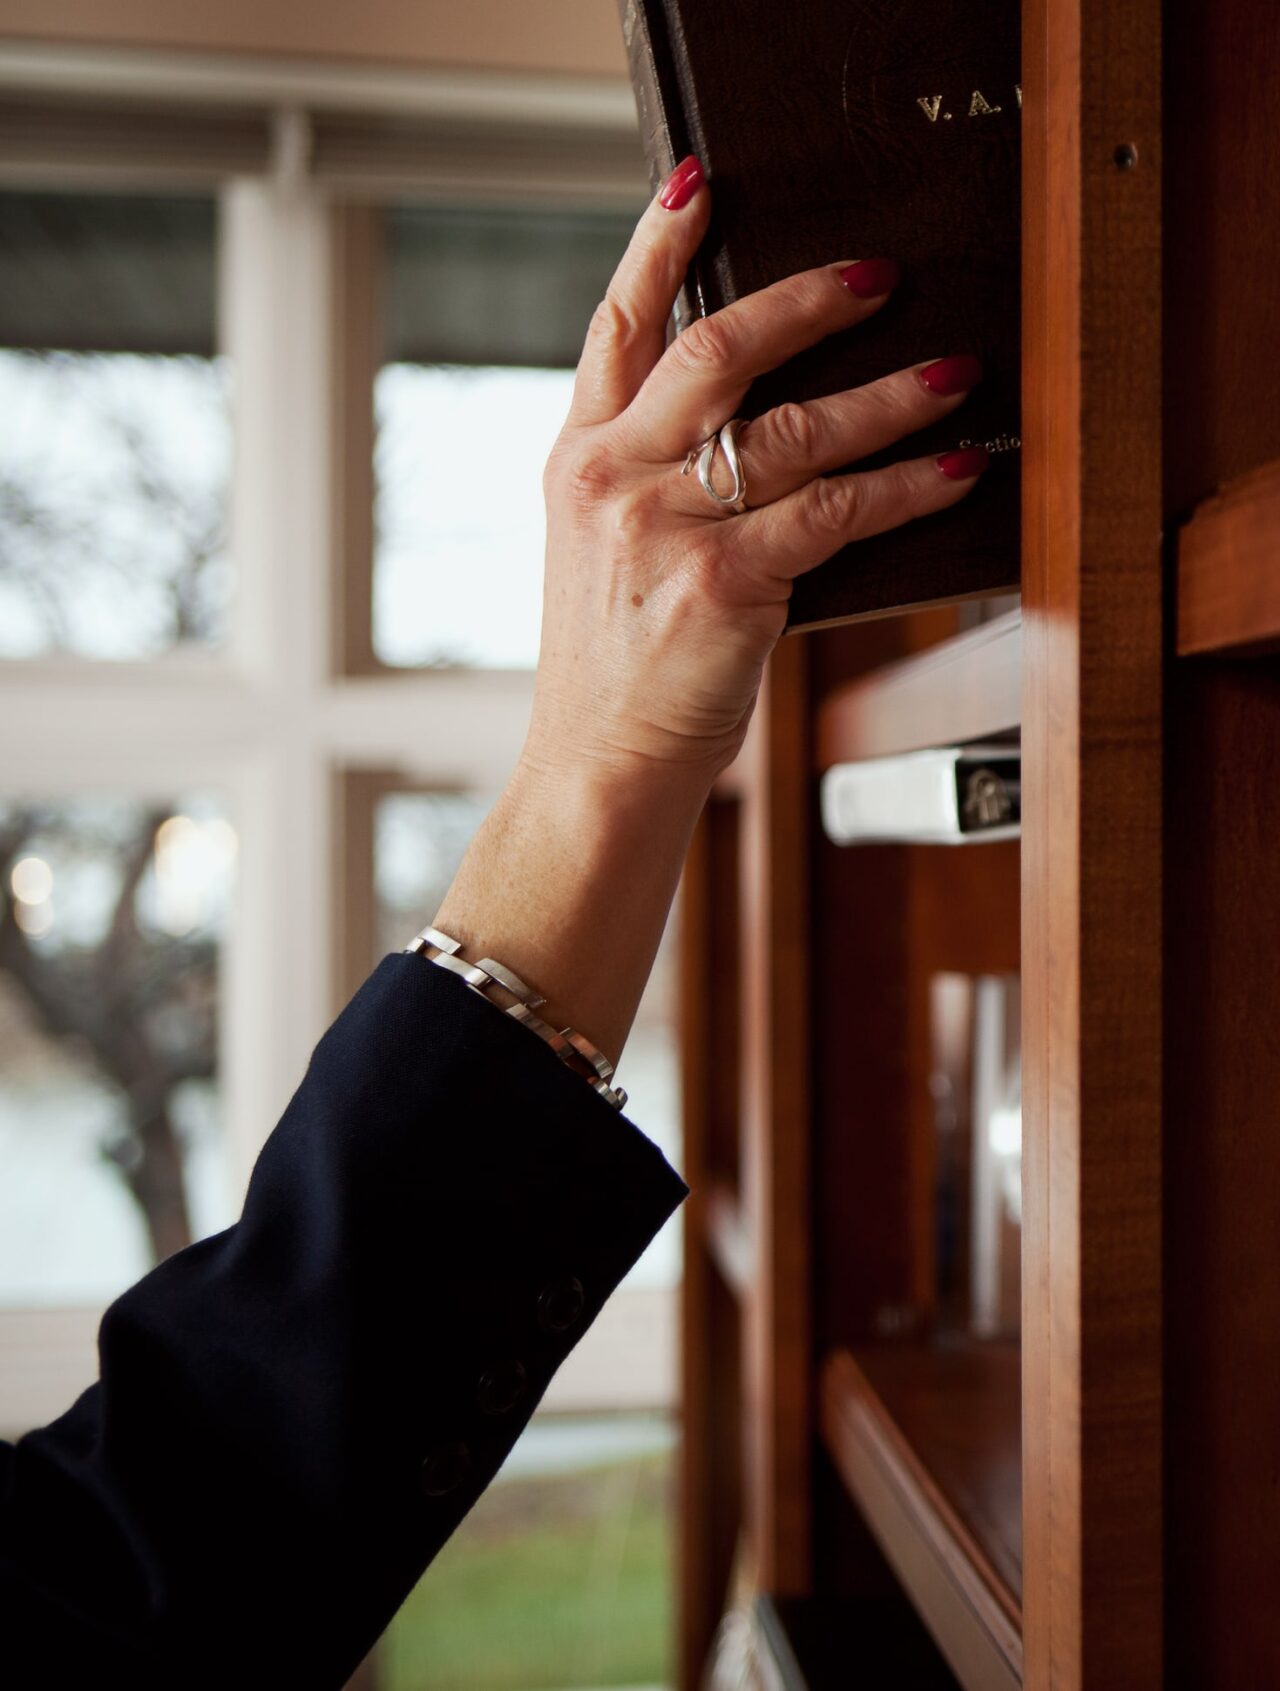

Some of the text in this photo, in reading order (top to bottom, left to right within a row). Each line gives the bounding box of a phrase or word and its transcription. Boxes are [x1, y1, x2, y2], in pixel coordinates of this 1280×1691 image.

[915, 94, 953, 122] V.
[967, 89, 1002, 118] A.
[959, 432, 1021, 454] Sctio
